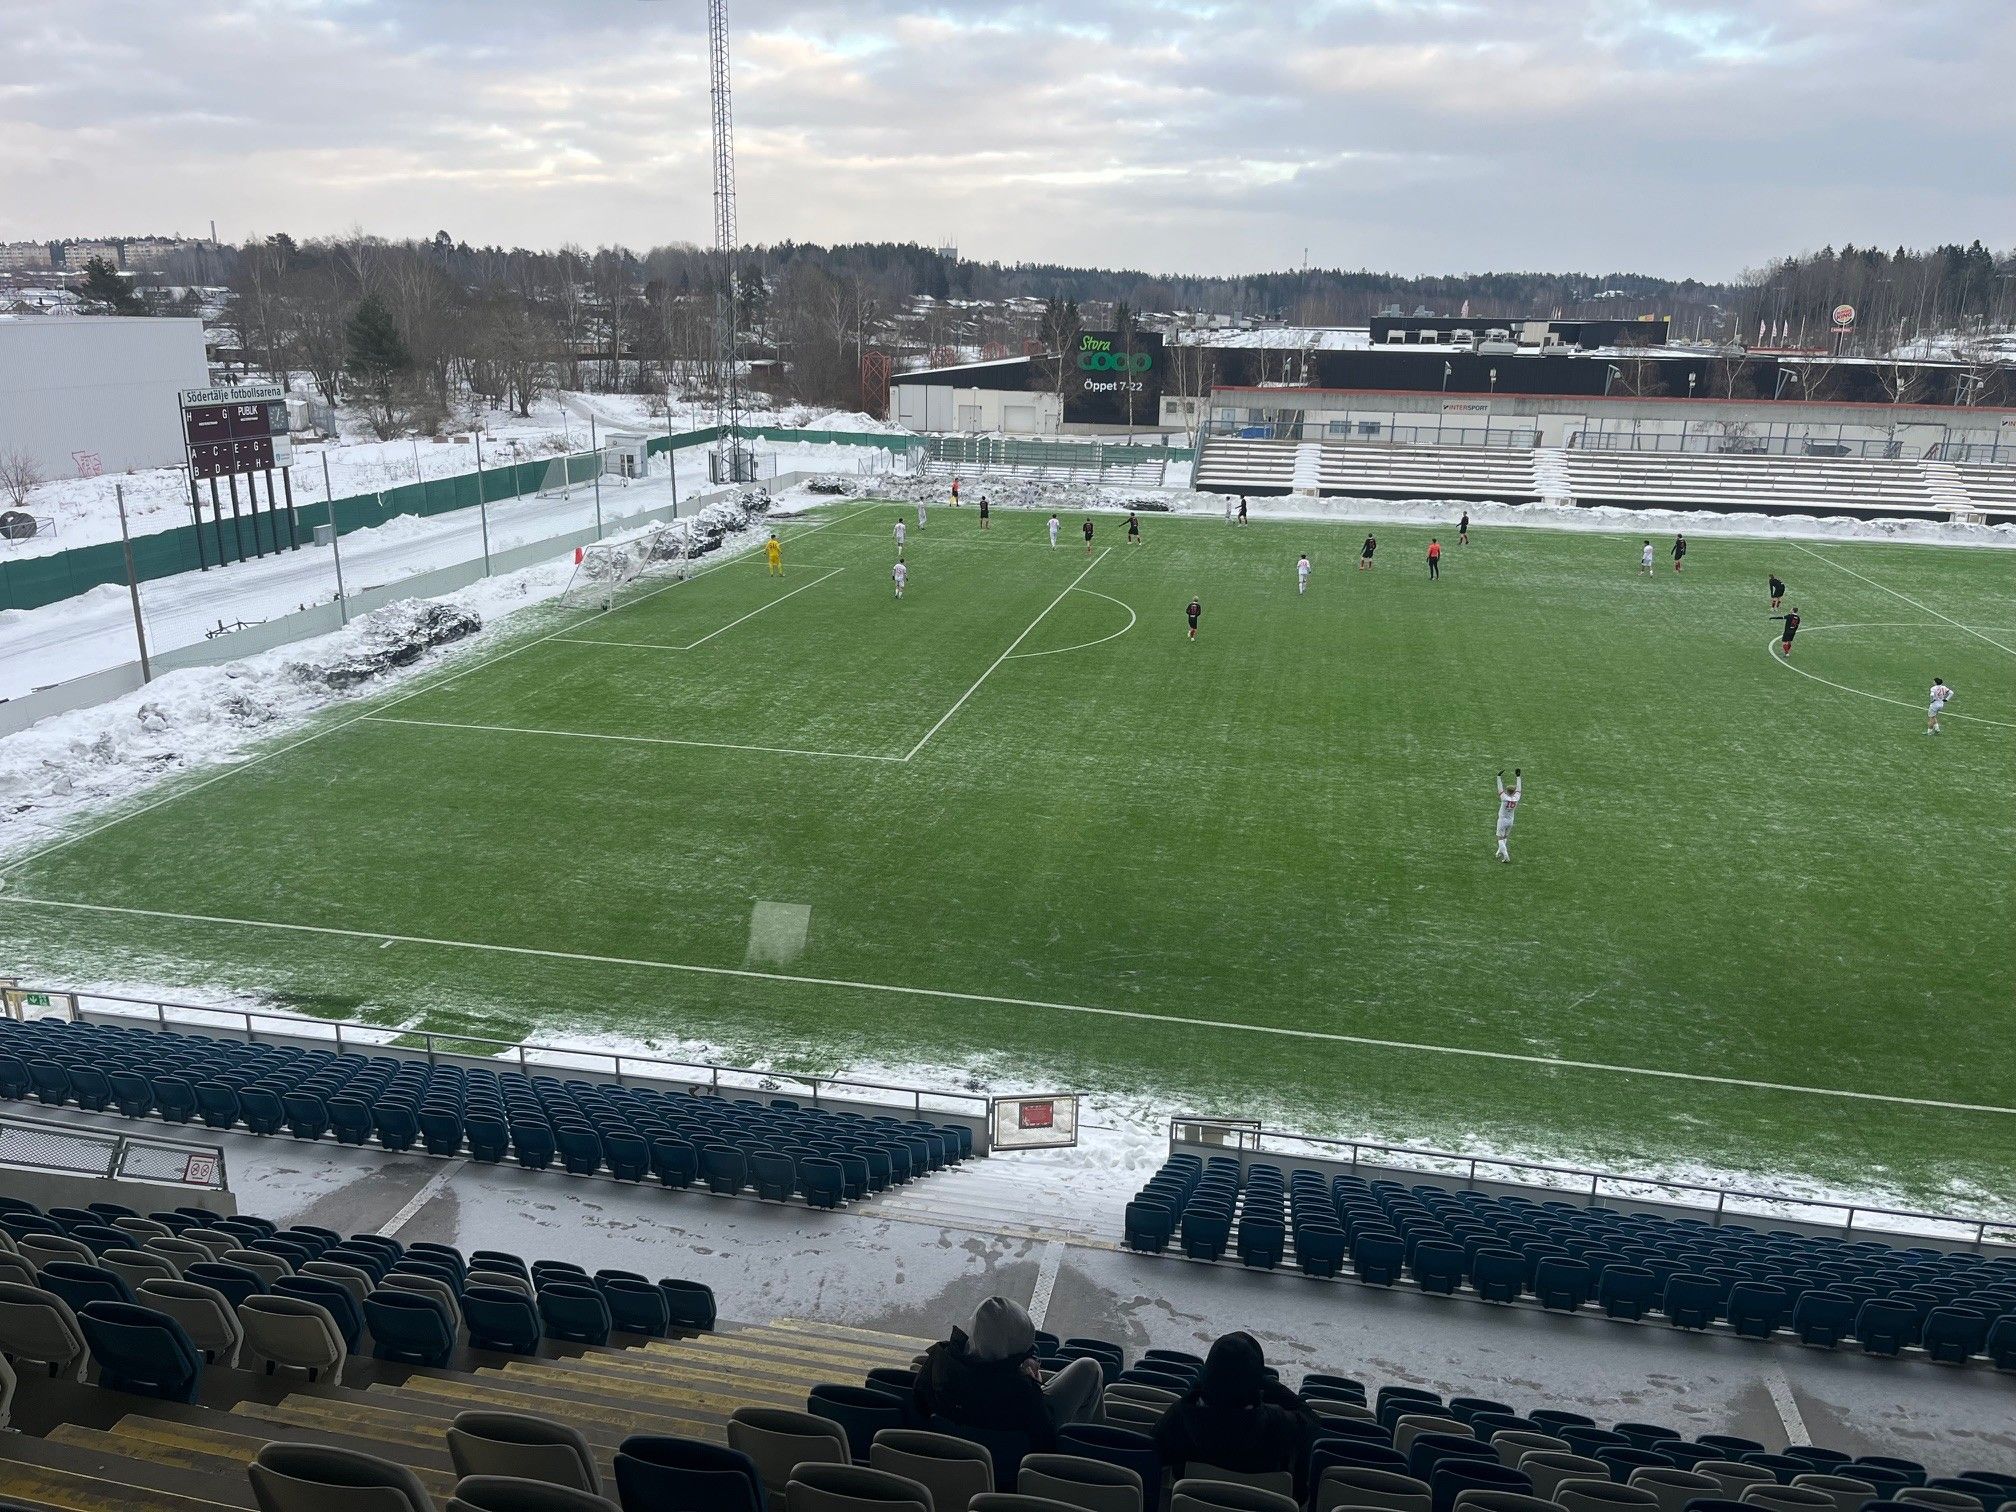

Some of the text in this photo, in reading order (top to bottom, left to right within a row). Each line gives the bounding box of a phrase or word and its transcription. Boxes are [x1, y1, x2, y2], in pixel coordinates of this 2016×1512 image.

[1080, 335, 1111, 351] Stora
[1084, 378, 1143, 392] Öppet 7-22
[187, 388, 281, 402] Södertälje fotbollsarena
[187, 412, 192, 421] H
[222, 409, 227, 418] G
[238, 405, 258, 416] PUBLIK
[192, 449, 197, 458] A
[213, 446, 218, 456] C
[234, 443, 239, 453] E
[253, 441, 258, 451] G
[194, 466, 199, 476] B
[215, 463, 220, 473] D
[237, 460, 240, 470] F
[256, 458, 261, 467] H
